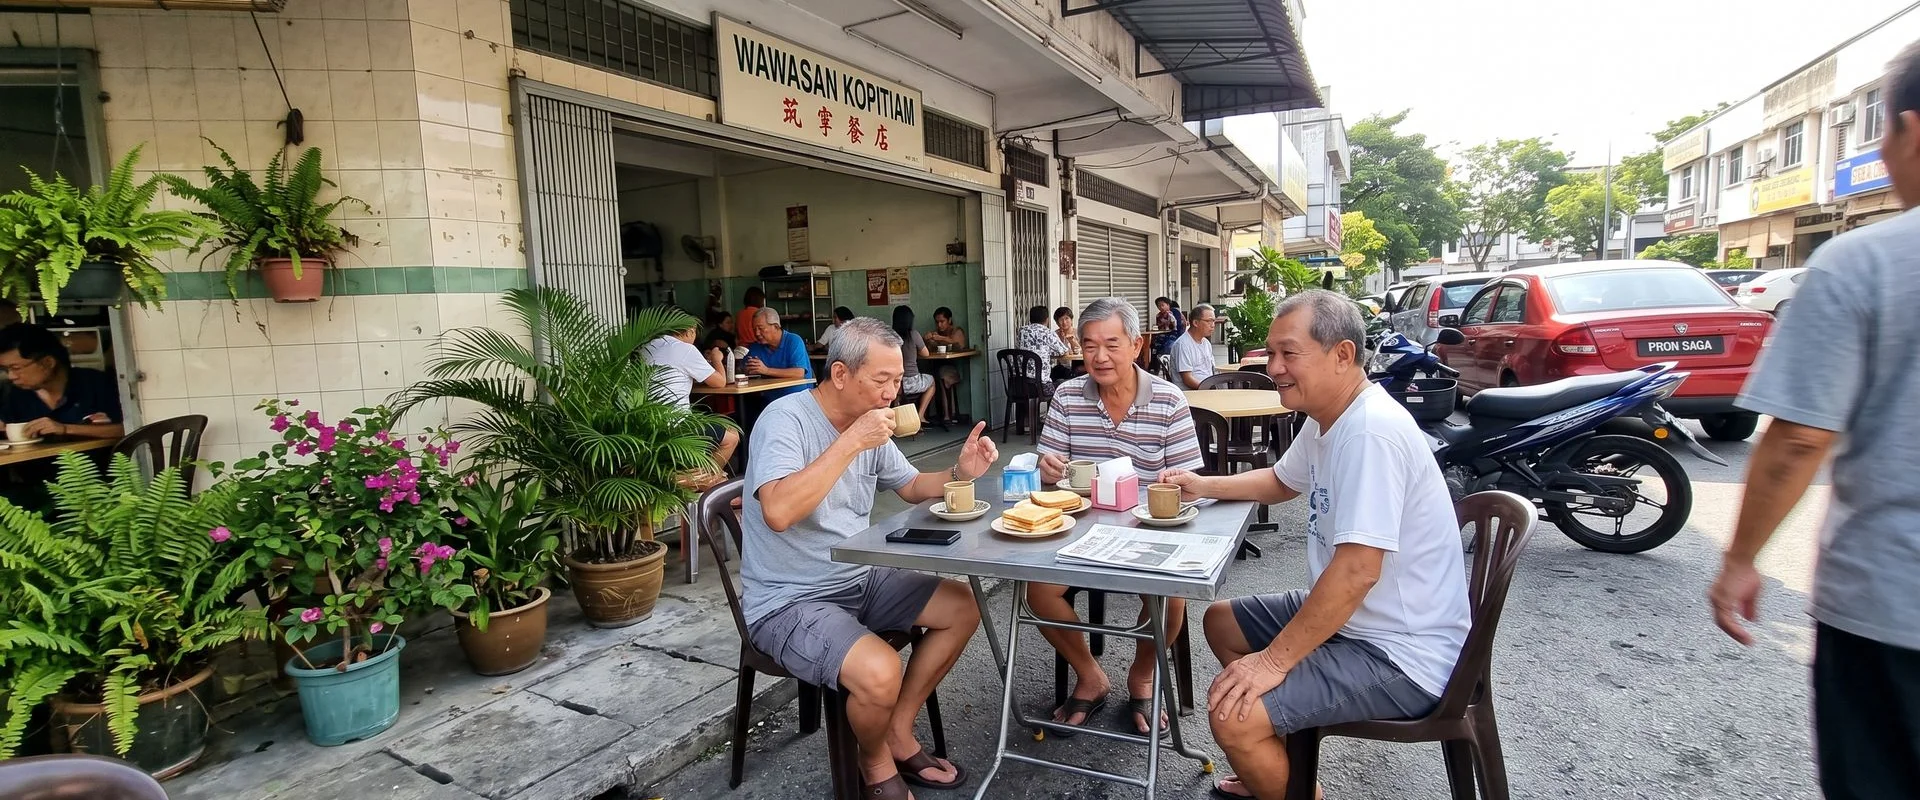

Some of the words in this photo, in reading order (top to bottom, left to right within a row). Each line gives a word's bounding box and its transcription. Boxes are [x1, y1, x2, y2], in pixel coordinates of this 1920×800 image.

[733, 34, 838, 102] WAWASAN
[843, 73, 915, 126] KOPITIAM
[1648, 341, 1680, 351] PRON
[1682, 340, 1712, 350] SAGA
